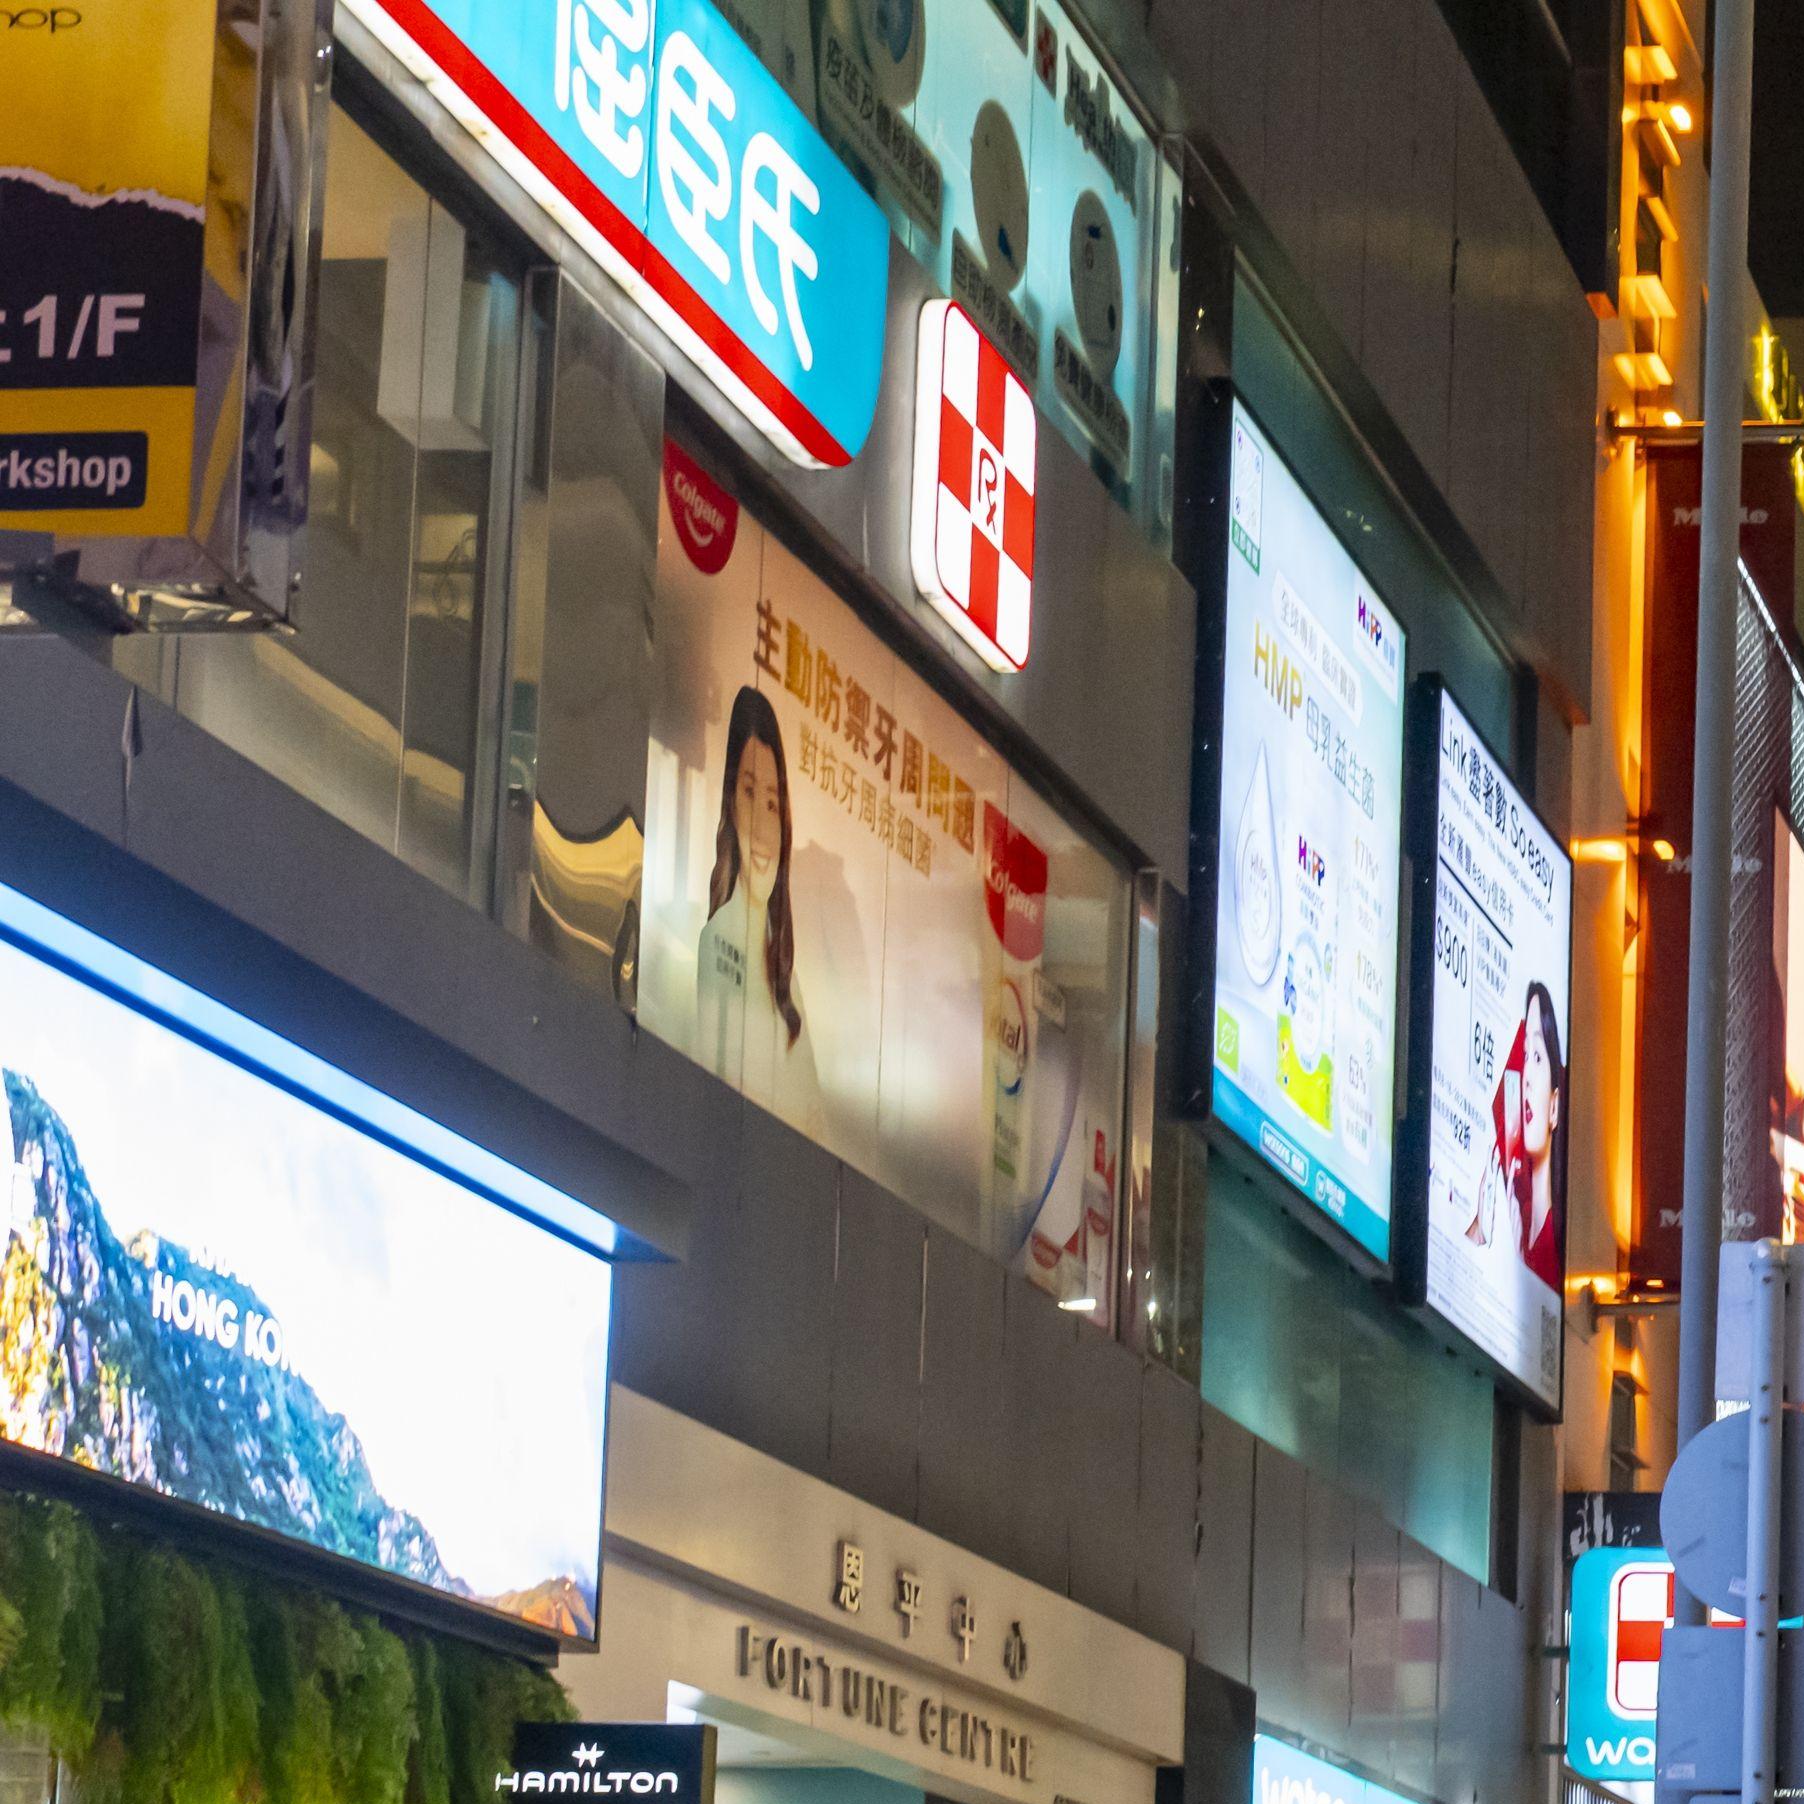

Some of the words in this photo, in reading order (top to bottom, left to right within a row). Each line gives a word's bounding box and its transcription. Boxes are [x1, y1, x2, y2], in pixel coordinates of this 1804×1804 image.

[672, 471, 727, 536] Colgate
[1254, 619, 1303, 722] HMP
[1306, 695, 1375, 821] 母乳益生菌
[1441, 707, 1468, 784] Link
[1527, 837, 1555, 904] easy
[986, 856, 1038, 922] Colgate
[1436, 914, 1468, 989] $900
[1473, 1020, 1495, 1081] 6倍
[152, 1270, 240, 1349] HONG
[737, 1624, 908, 1737] FORTUNE
[919, 1696, 1034, 1782] CENTRE
[495, 1768, 679, 1796] HAMILTON
